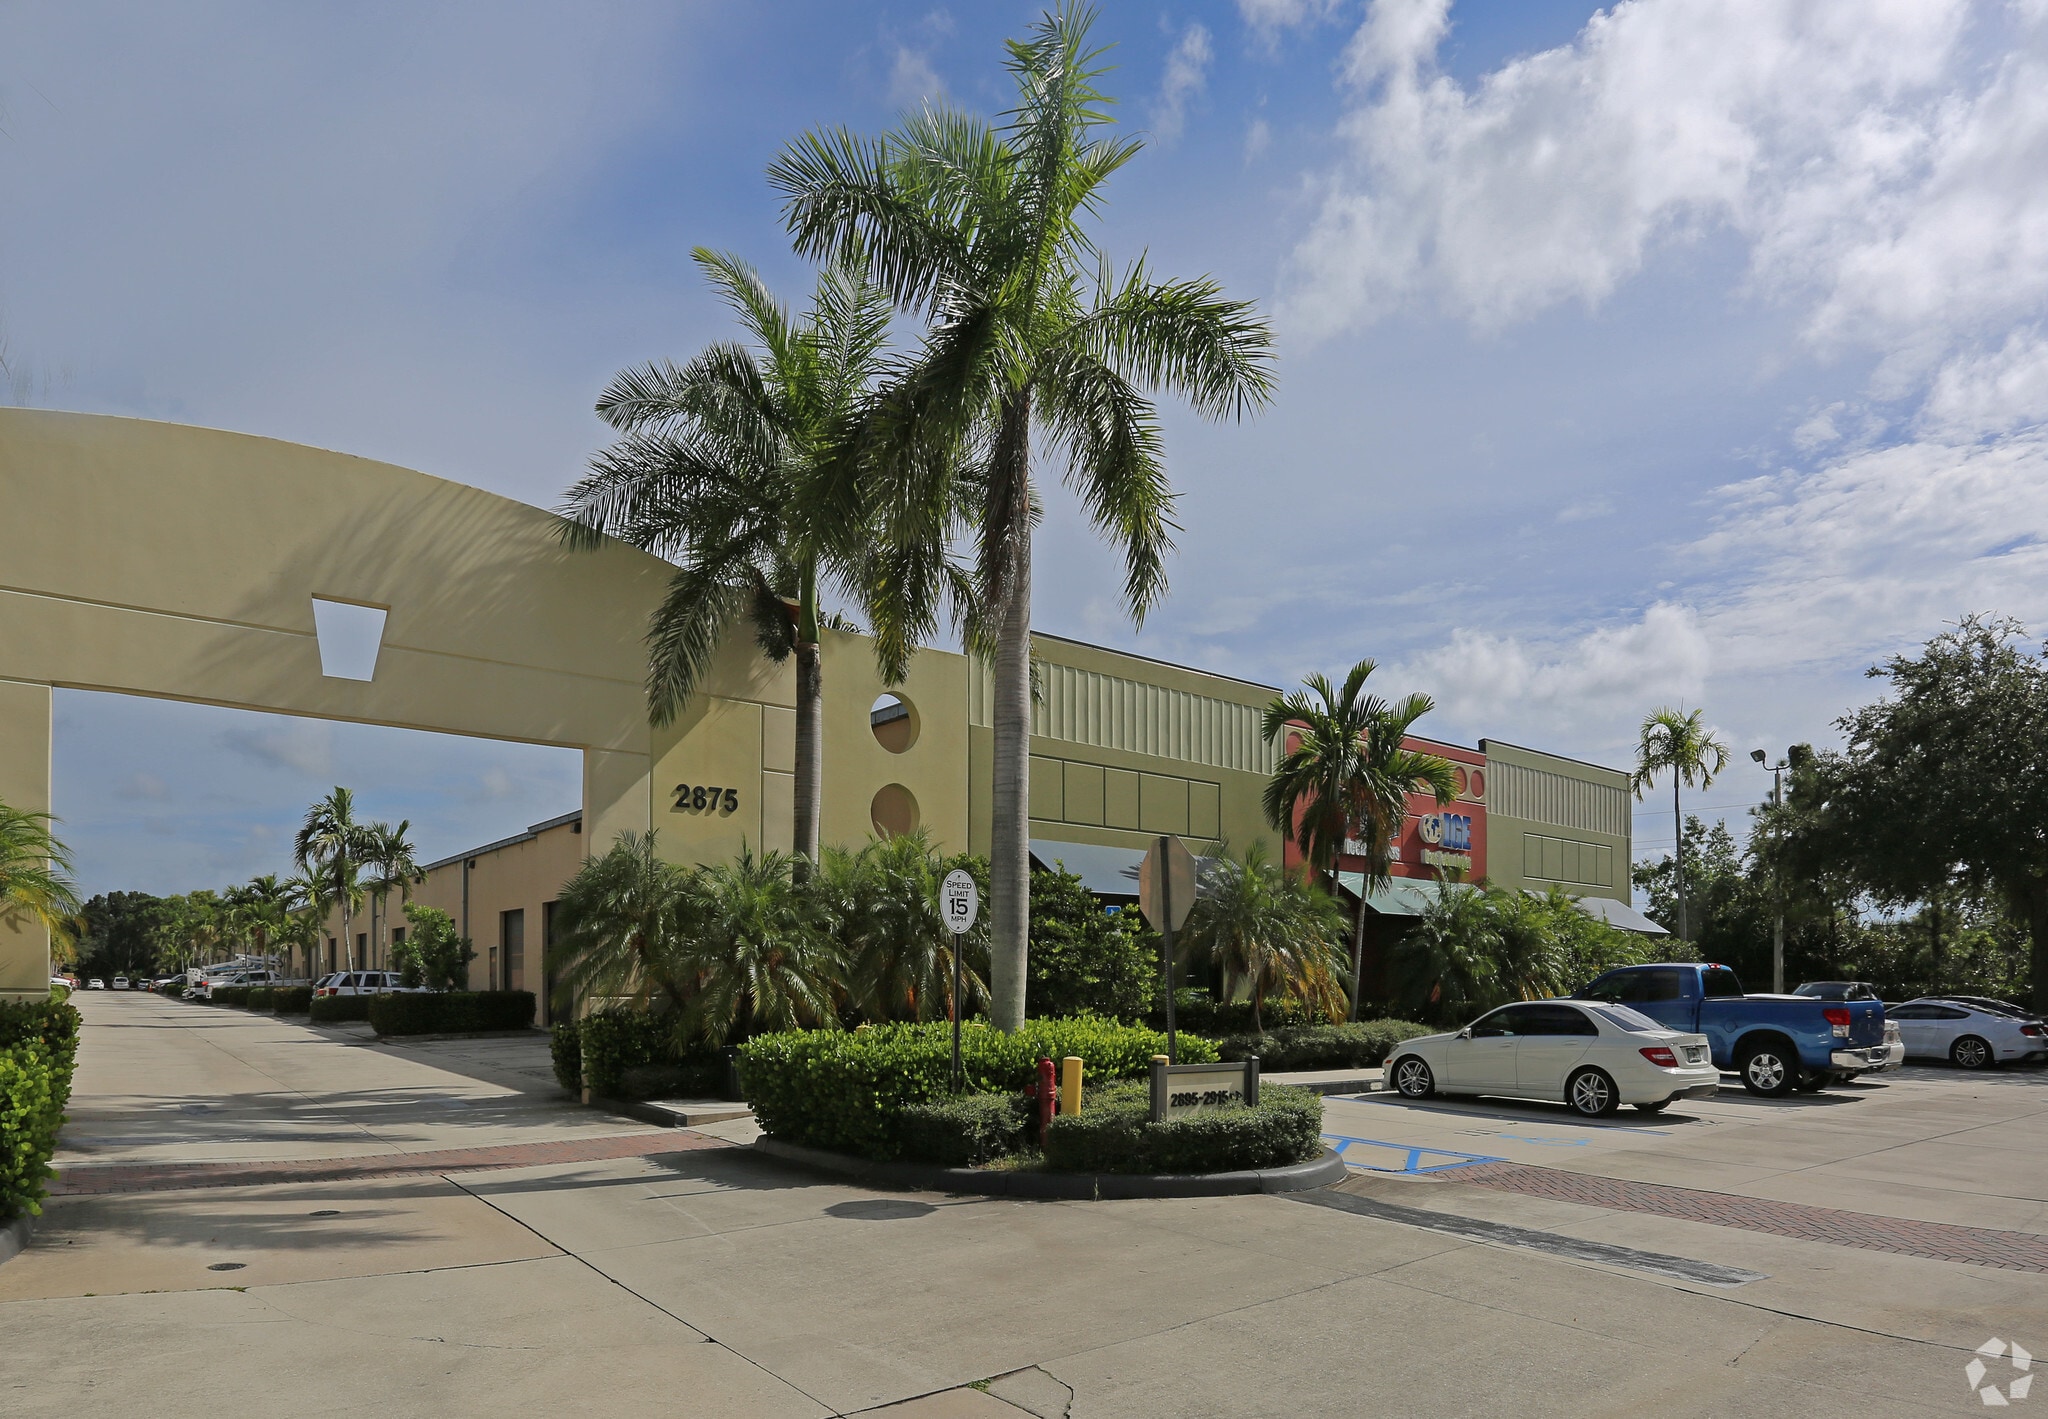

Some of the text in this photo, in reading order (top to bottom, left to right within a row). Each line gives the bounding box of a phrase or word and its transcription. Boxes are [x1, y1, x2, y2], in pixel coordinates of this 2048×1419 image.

[675, 783, 739, 813] 2875
[946, 880, 972, 890] SPEED
[948, 889, 970, 898] LIMIT
[949, 897, 969, 916] 15
[950, 915, 967, 923] MPH
